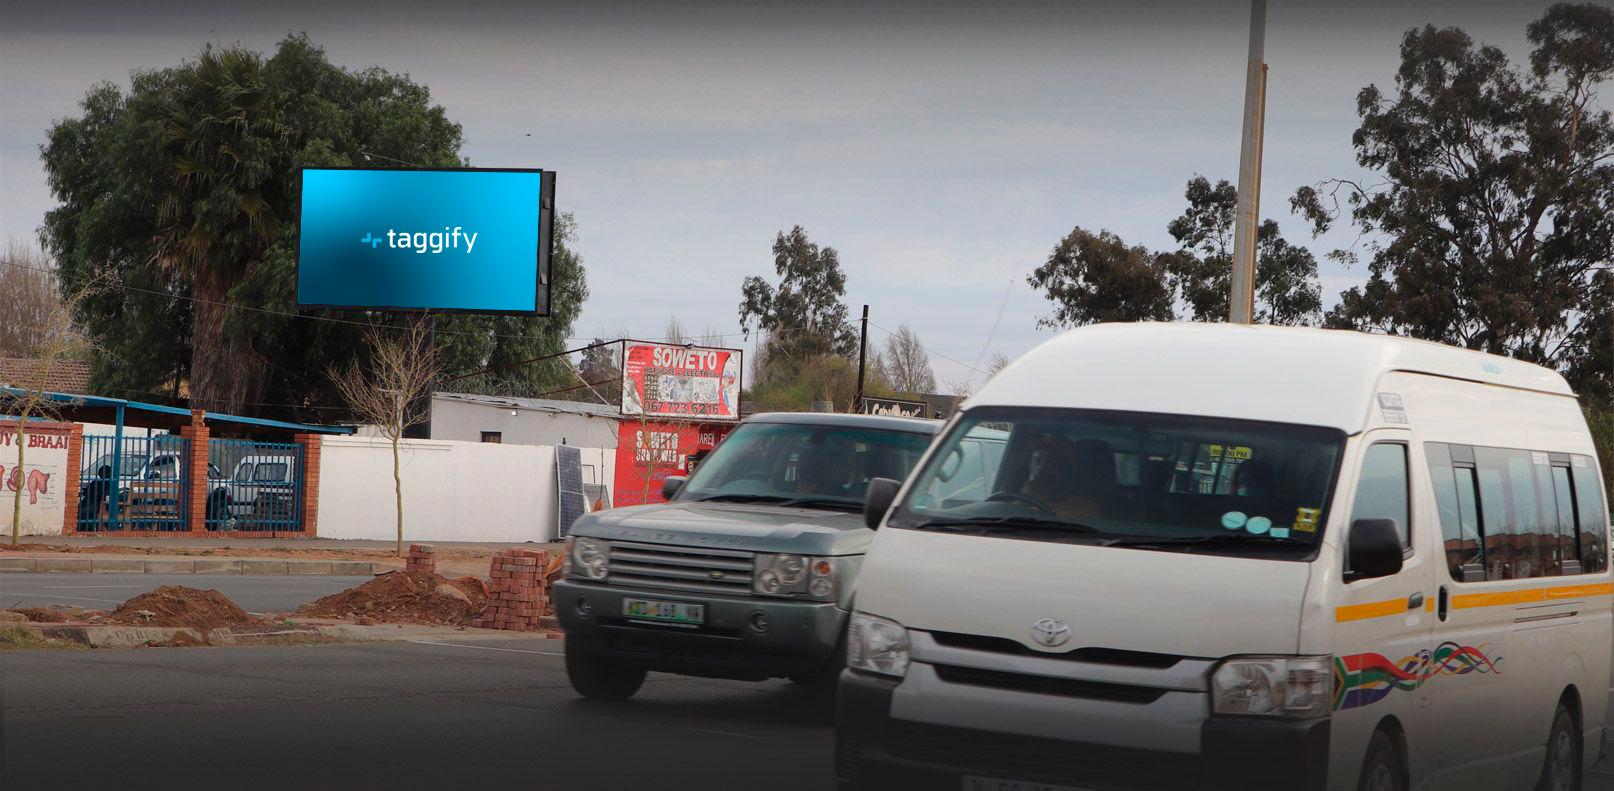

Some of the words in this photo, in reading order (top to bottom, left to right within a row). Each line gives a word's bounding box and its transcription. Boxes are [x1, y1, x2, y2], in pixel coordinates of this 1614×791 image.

[386, 226, 478, 254] taggify
[653, 347, 717, 371] SOWETO
[667, 402, 688, 414] 723
[691, 403, 719, 415] 6216
[28, 434, 68, 449] BRAAI
[636, 430, 679, 450] SWETO
